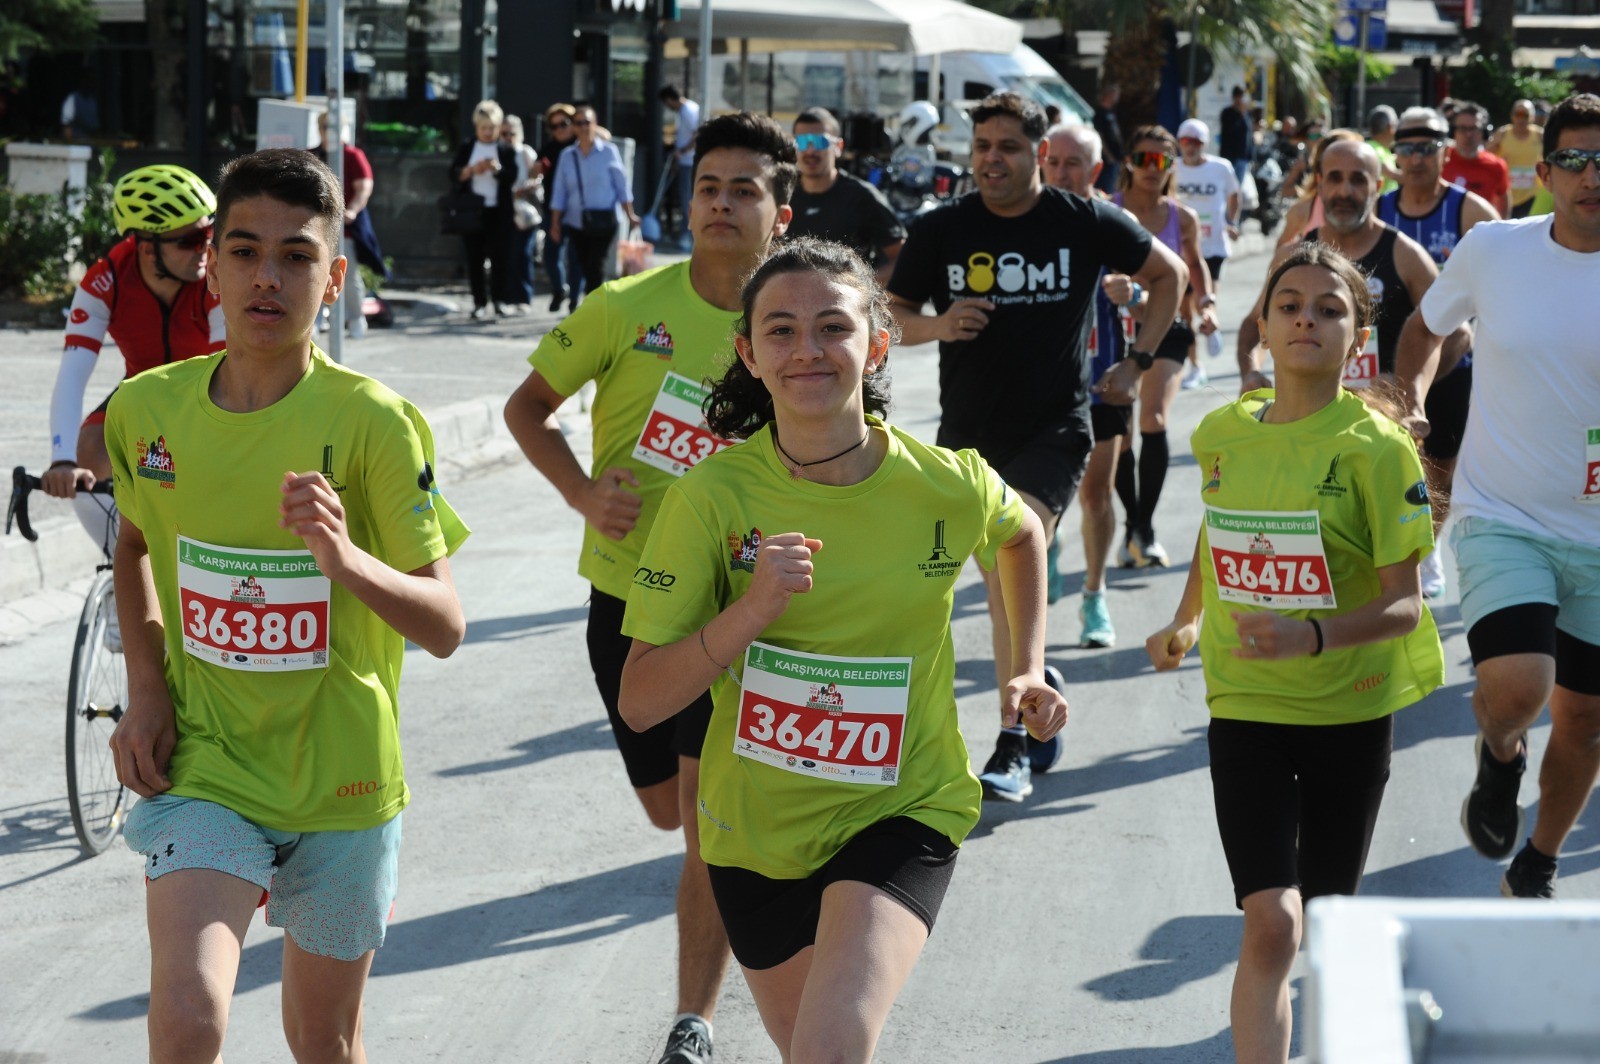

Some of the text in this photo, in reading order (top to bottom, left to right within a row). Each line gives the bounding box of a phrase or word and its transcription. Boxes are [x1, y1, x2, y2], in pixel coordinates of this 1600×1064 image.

[991, 294, 1034, 305] Training
[649, 421, 730, 466] 363
[1219, 516, 1316, 531] KARŞIYAKA BELEDİYESİ
[198, 553, 258, 571] KARŞIYAKA
[928, 561, 961, 571] KARŞIYAKA
[1220, 555, 1320, 593] 36476
[188, 599, 318, 651] 36380
[774, 659, 841, 679] KARŞIYAKA
[842, 668, 906, 680] BELEDİYESİ
[749, 703, 891, 762] 36470
[336, 780, 377, 798] otto
